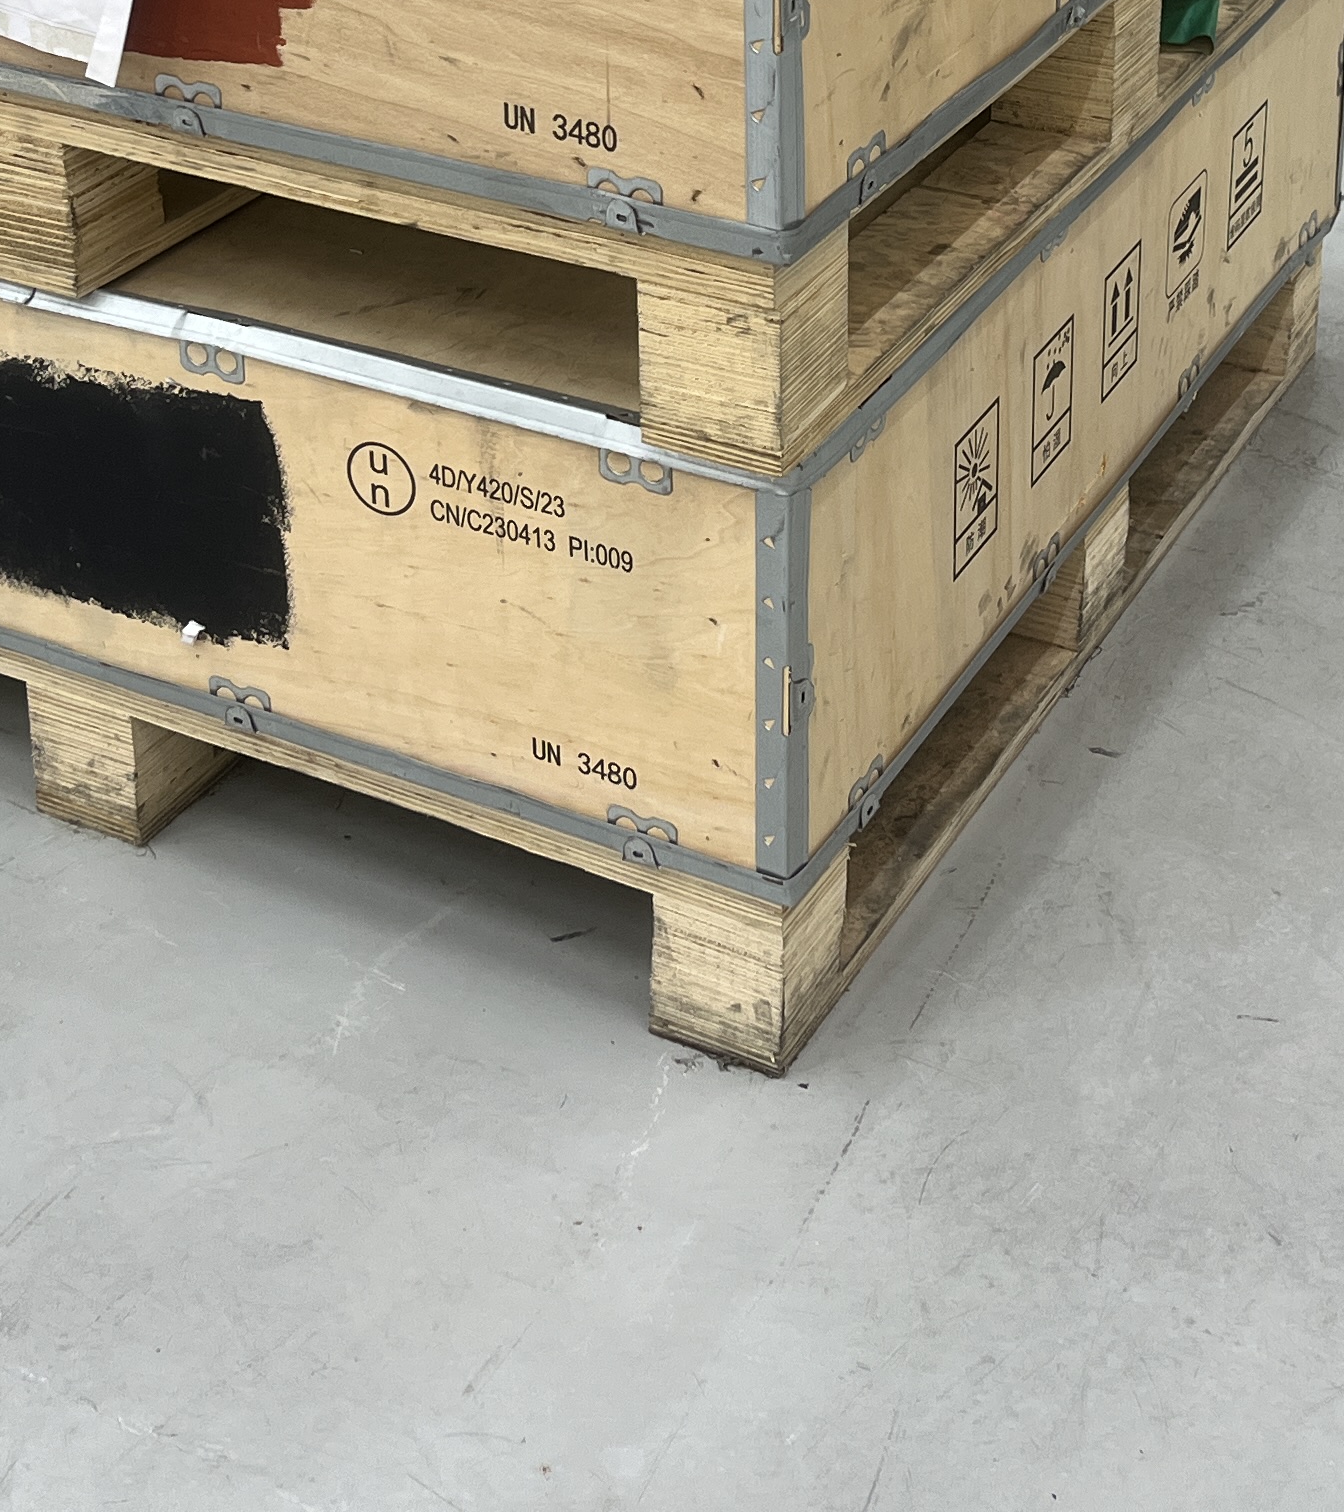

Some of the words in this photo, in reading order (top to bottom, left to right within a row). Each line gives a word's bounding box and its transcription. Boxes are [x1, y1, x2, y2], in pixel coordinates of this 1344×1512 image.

[503, 102, 535, 134] UN
[552, 114, 617, 152] 3480
[1243, 122, 1254, 168] 5
[429, 464, 565, 518] 4D/Y420/S/23
[430, 499, 556, 552] CN/C230413
[568, 536, 633, 573] PI:009
[532, 737, 561, 766] UN
[577, 752, 637, 790] 3480
